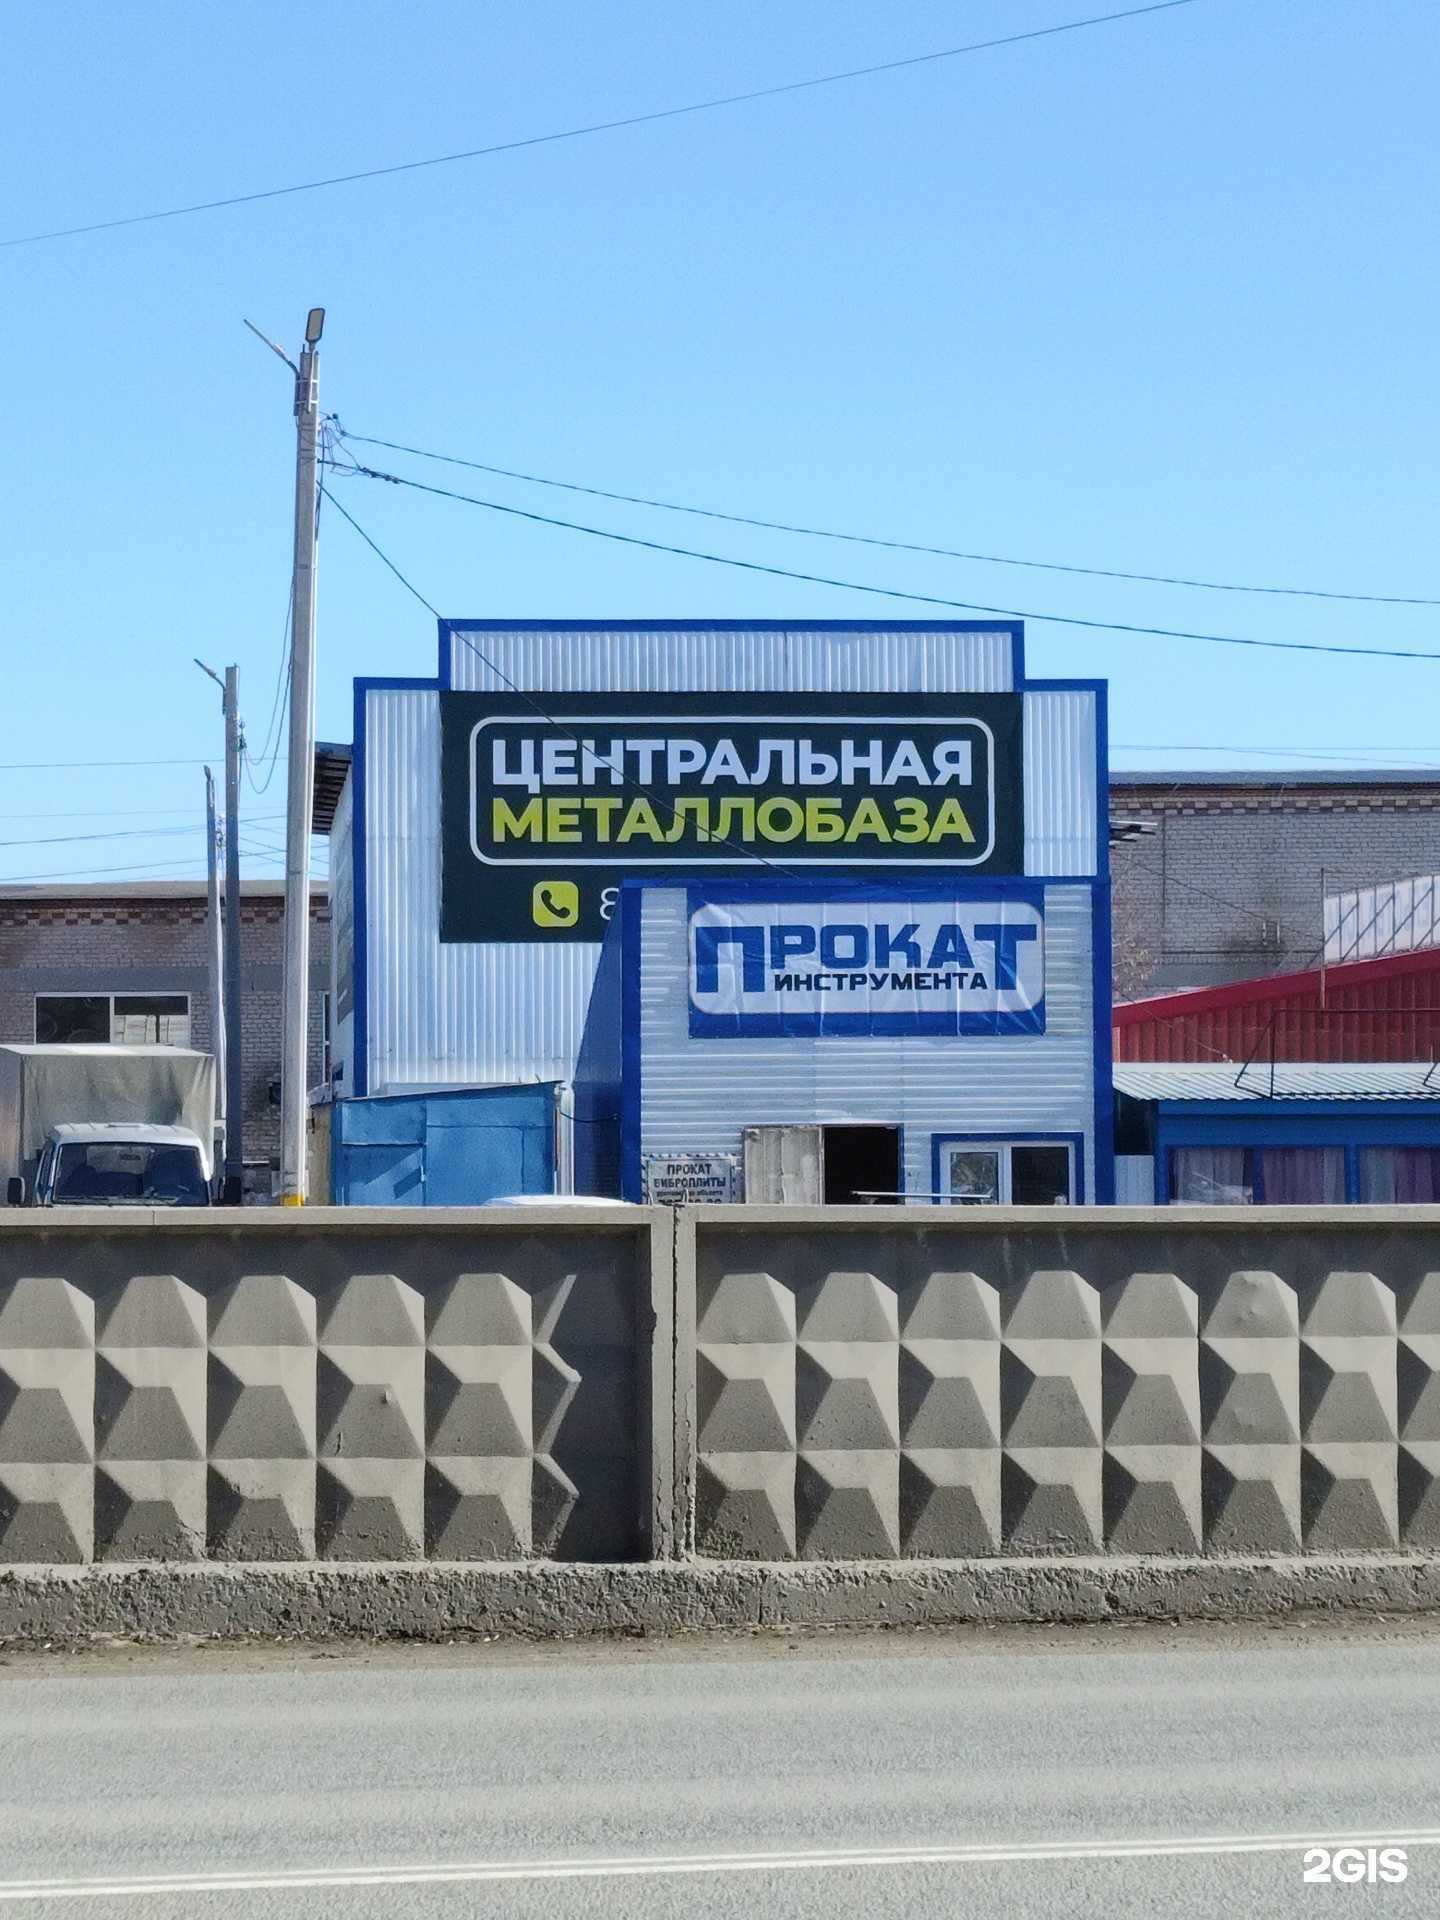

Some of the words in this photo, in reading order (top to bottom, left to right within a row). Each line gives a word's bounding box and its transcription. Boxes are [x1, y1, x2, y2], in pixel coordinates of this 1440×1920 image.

[492, 739, 972, 793] ЦЕНТРАЛЬНАЯ
[492, 797, 976, 843] МЕТАЛЛОБАЗА
[695, 923, 1038, 993] ПРОКАТ
[774, 973, 987, 991] ИНСТРУМЕНТА
[667, 1163, 712, 1175] ПРОКАТ
